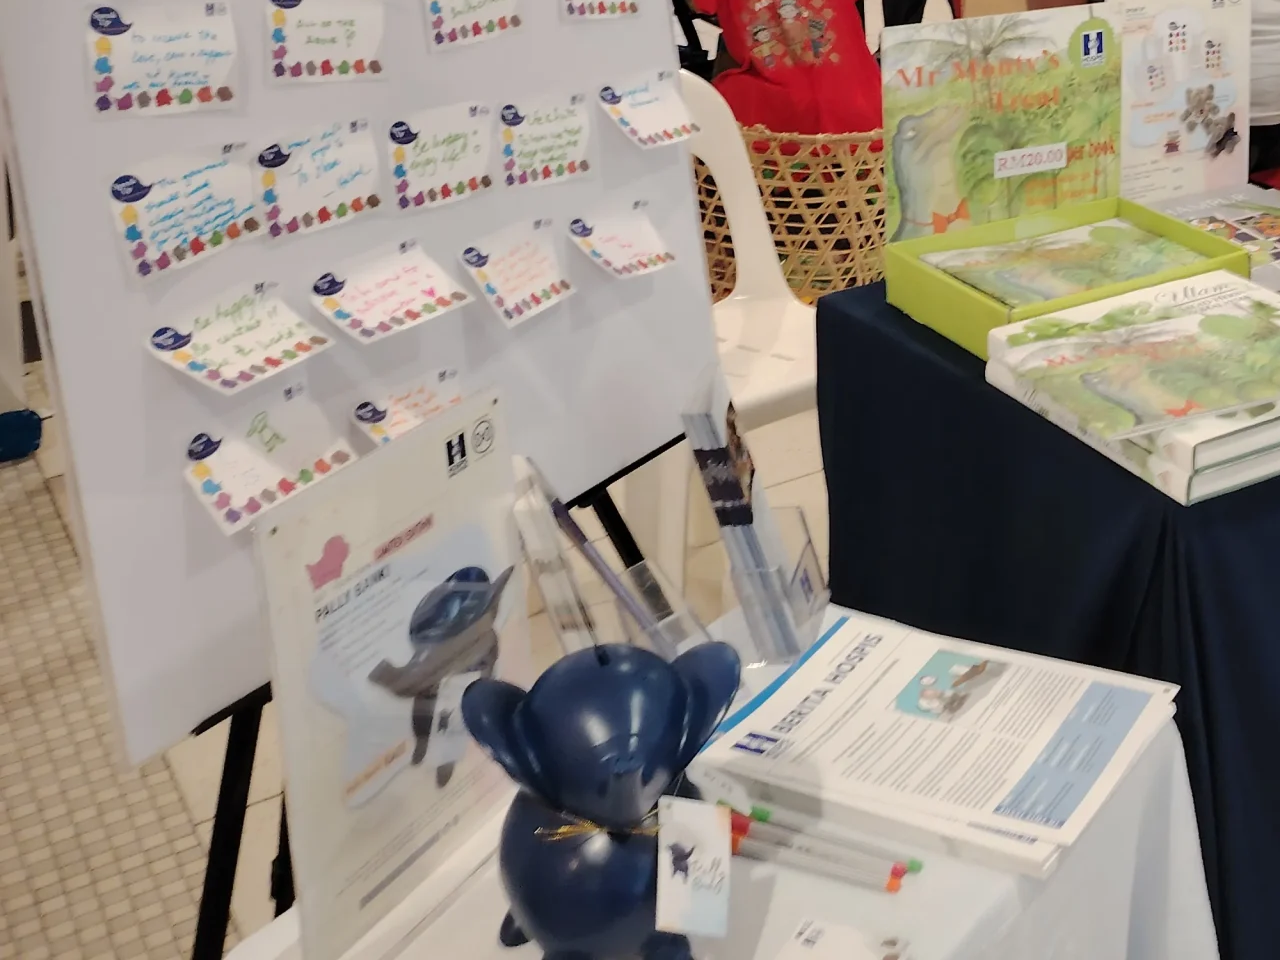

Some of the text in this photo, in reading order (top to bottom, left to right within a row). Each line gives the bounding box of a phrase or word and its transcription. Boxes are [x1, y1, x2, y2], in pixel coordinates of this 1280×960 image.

[897, 65, 942, 88] Mr
[770, 688, 835, 734] BERITA
[823, 633, 884, 685] HOSPIS
